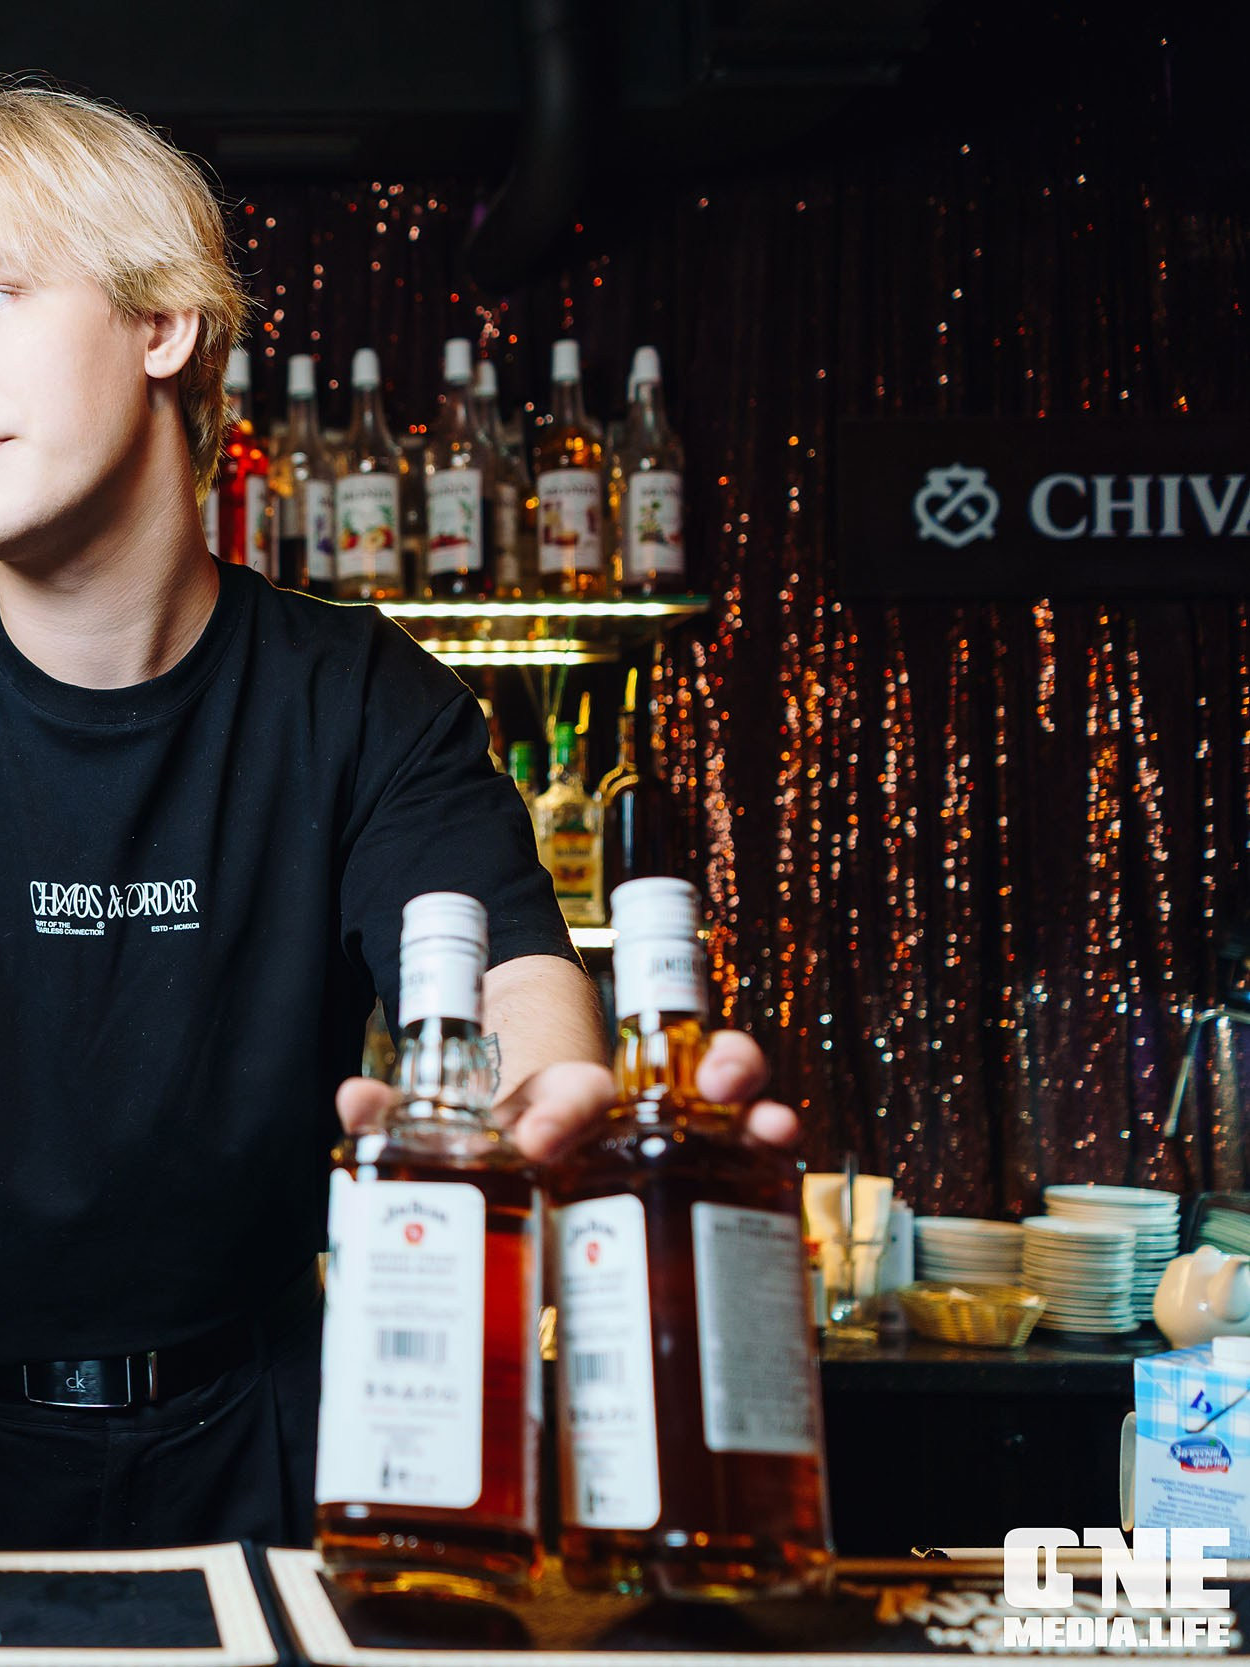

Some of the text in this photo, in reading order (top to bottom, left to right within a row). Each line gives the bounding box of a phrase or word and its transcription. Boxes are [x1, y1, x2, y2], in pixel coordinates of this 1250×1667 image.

[29, 878, 199, 919] CHAOS & ORDER
[36, 926, 104, 936] ARLESS CONNECTION
